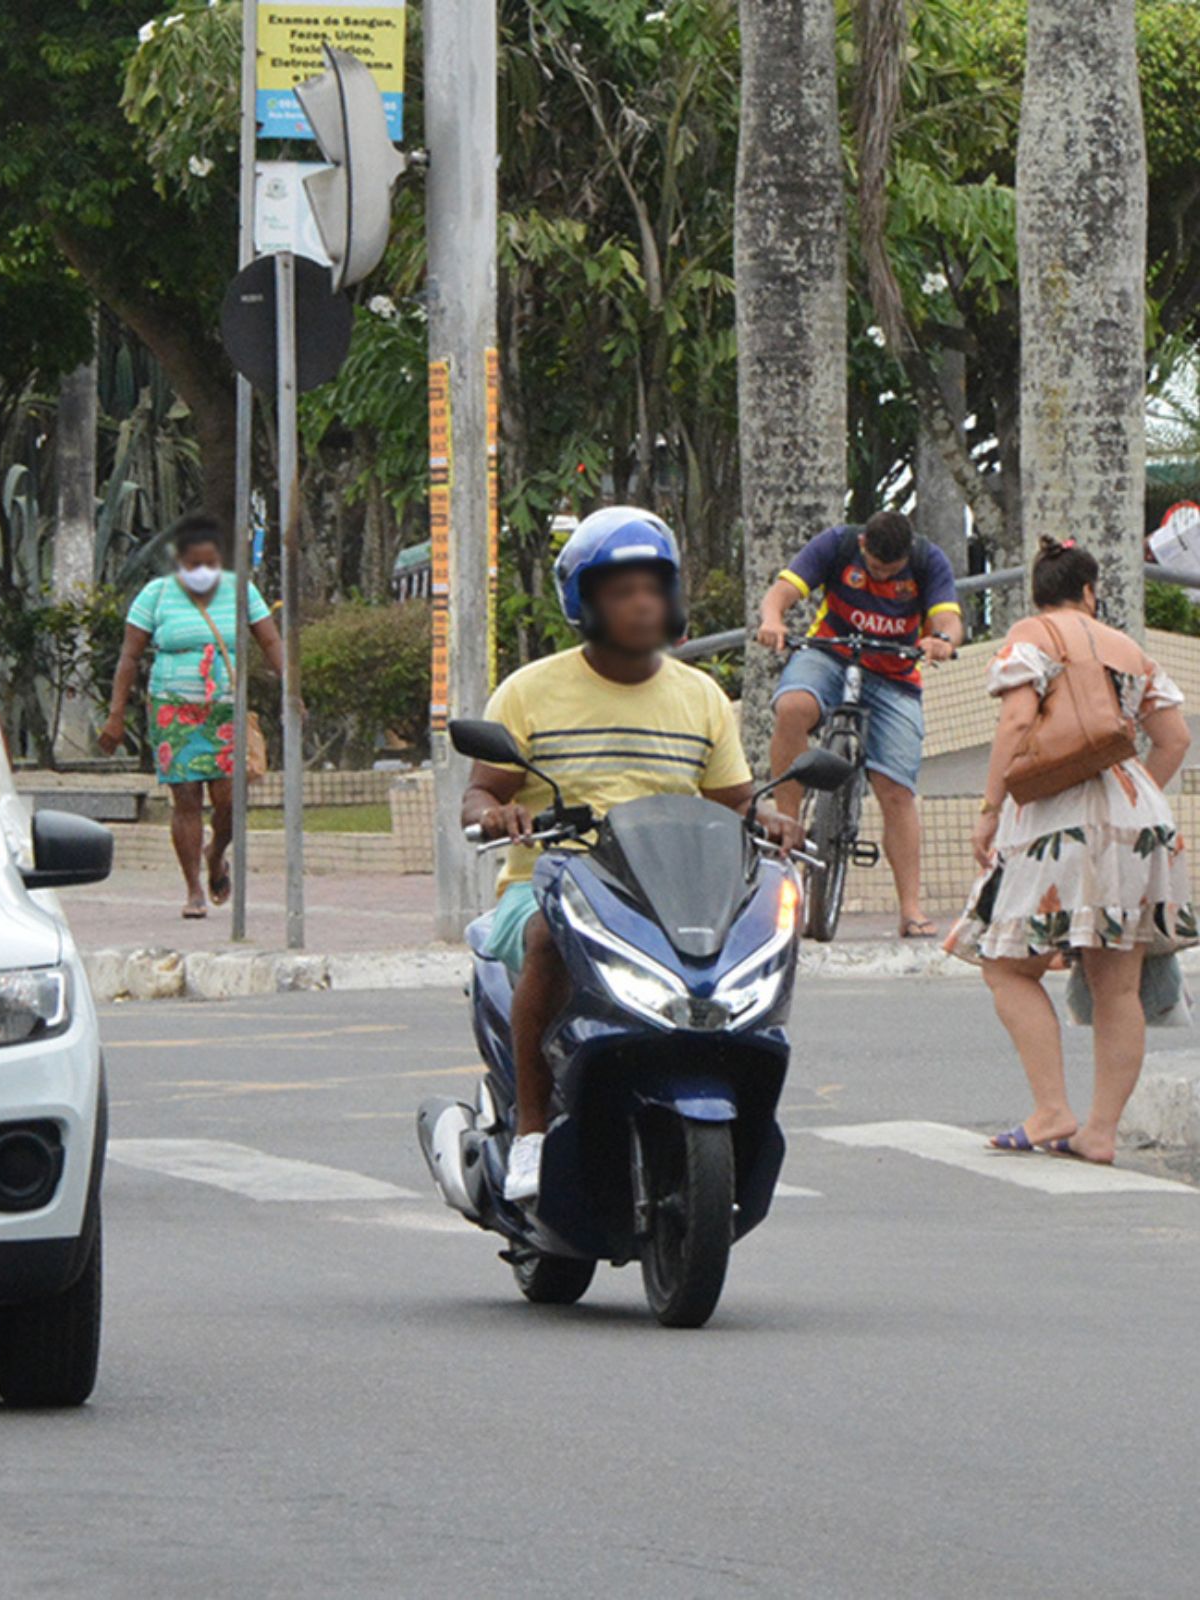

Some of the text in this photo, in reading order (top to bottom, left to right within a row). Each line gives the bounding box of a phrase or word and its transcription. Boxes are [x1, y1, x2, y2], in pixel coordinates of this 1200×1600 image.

[268, 14, 397, 29] Exames de Sangue,
[290, 29, 375, 42] Fezes, Urina,
[850, 610, 907, 635] QATAR
